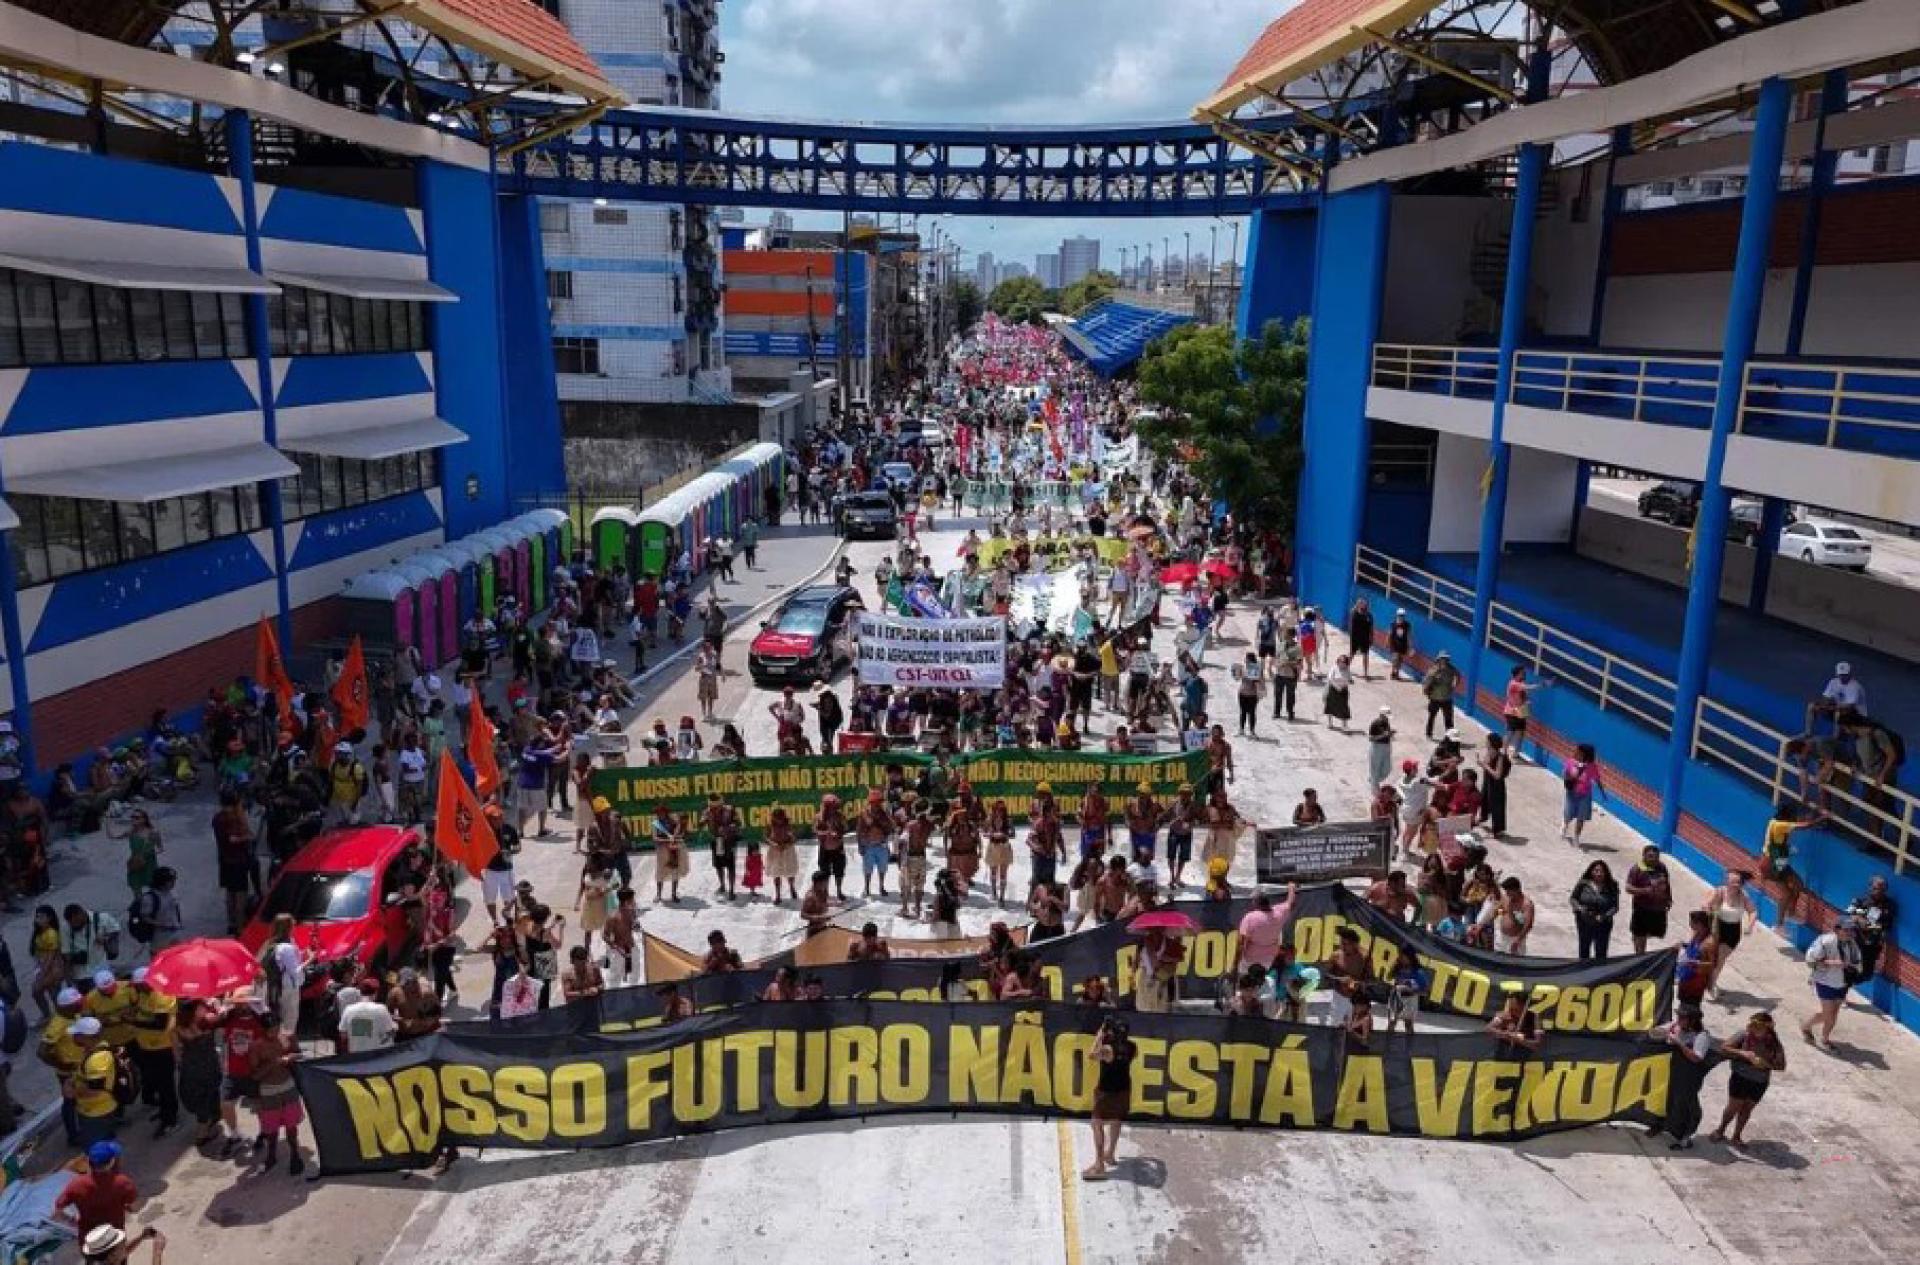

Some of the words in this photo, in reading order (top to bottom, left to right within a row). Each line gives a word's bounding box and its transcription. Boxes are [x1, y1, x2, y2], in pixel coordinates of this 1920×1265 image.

[618, 779, 630, 801] A
[634, 776, 690, 800] NOSSA
[694, 770, 774, 796] FLORESTA
[779, 764, 813, 790] NÃO
[816, 762, 855, 789] ESTÁ
[968, 759, 998, 783] NÃO
[1004, 761, 1104, 782] NEGOCIAMOS
[1110, 764, 1121, 782] A
[1166, 762, 1188, 783] DA
[336, 1062, 607, 1159] NOSSO
[626, 1022, 931, 1130] FUTURO
[949, 1010, 1101, 1112] NÃO
[1128, 1033, 1316, 1127] ESTÁ
[1333, 1055, 1390, 1133] A
[1411, 1053, 1673, 1137] VENDA
